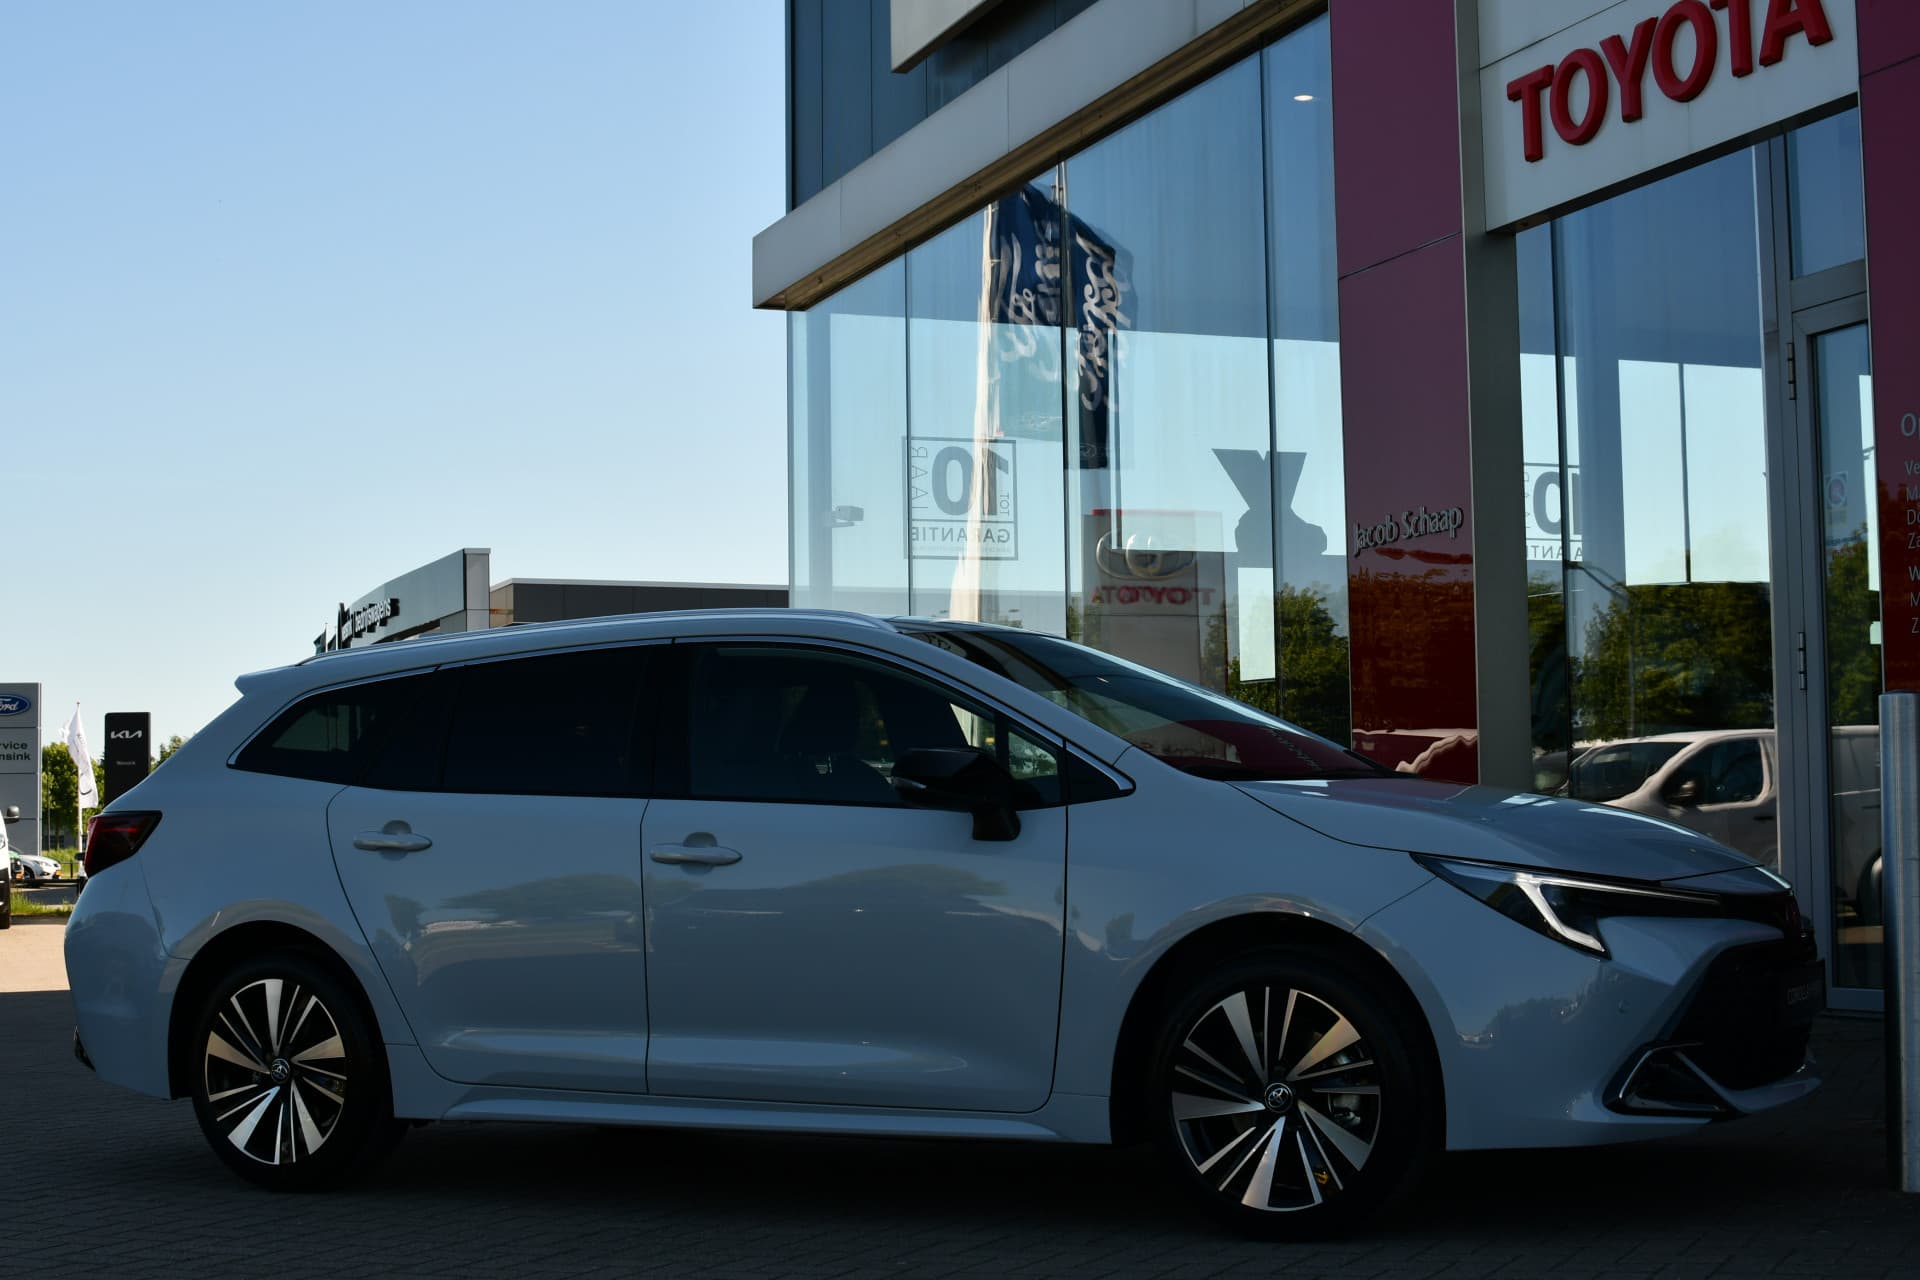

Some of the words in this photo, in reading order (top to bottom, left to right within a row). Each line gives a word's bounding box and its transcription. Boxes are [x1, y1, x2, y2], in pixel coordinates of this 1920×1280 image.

[1507, 0, 1833, 163] TOYOTA
[1353, 513, 1400, 556] Jacob
[1400, 506, 1463, 539] Schaap
